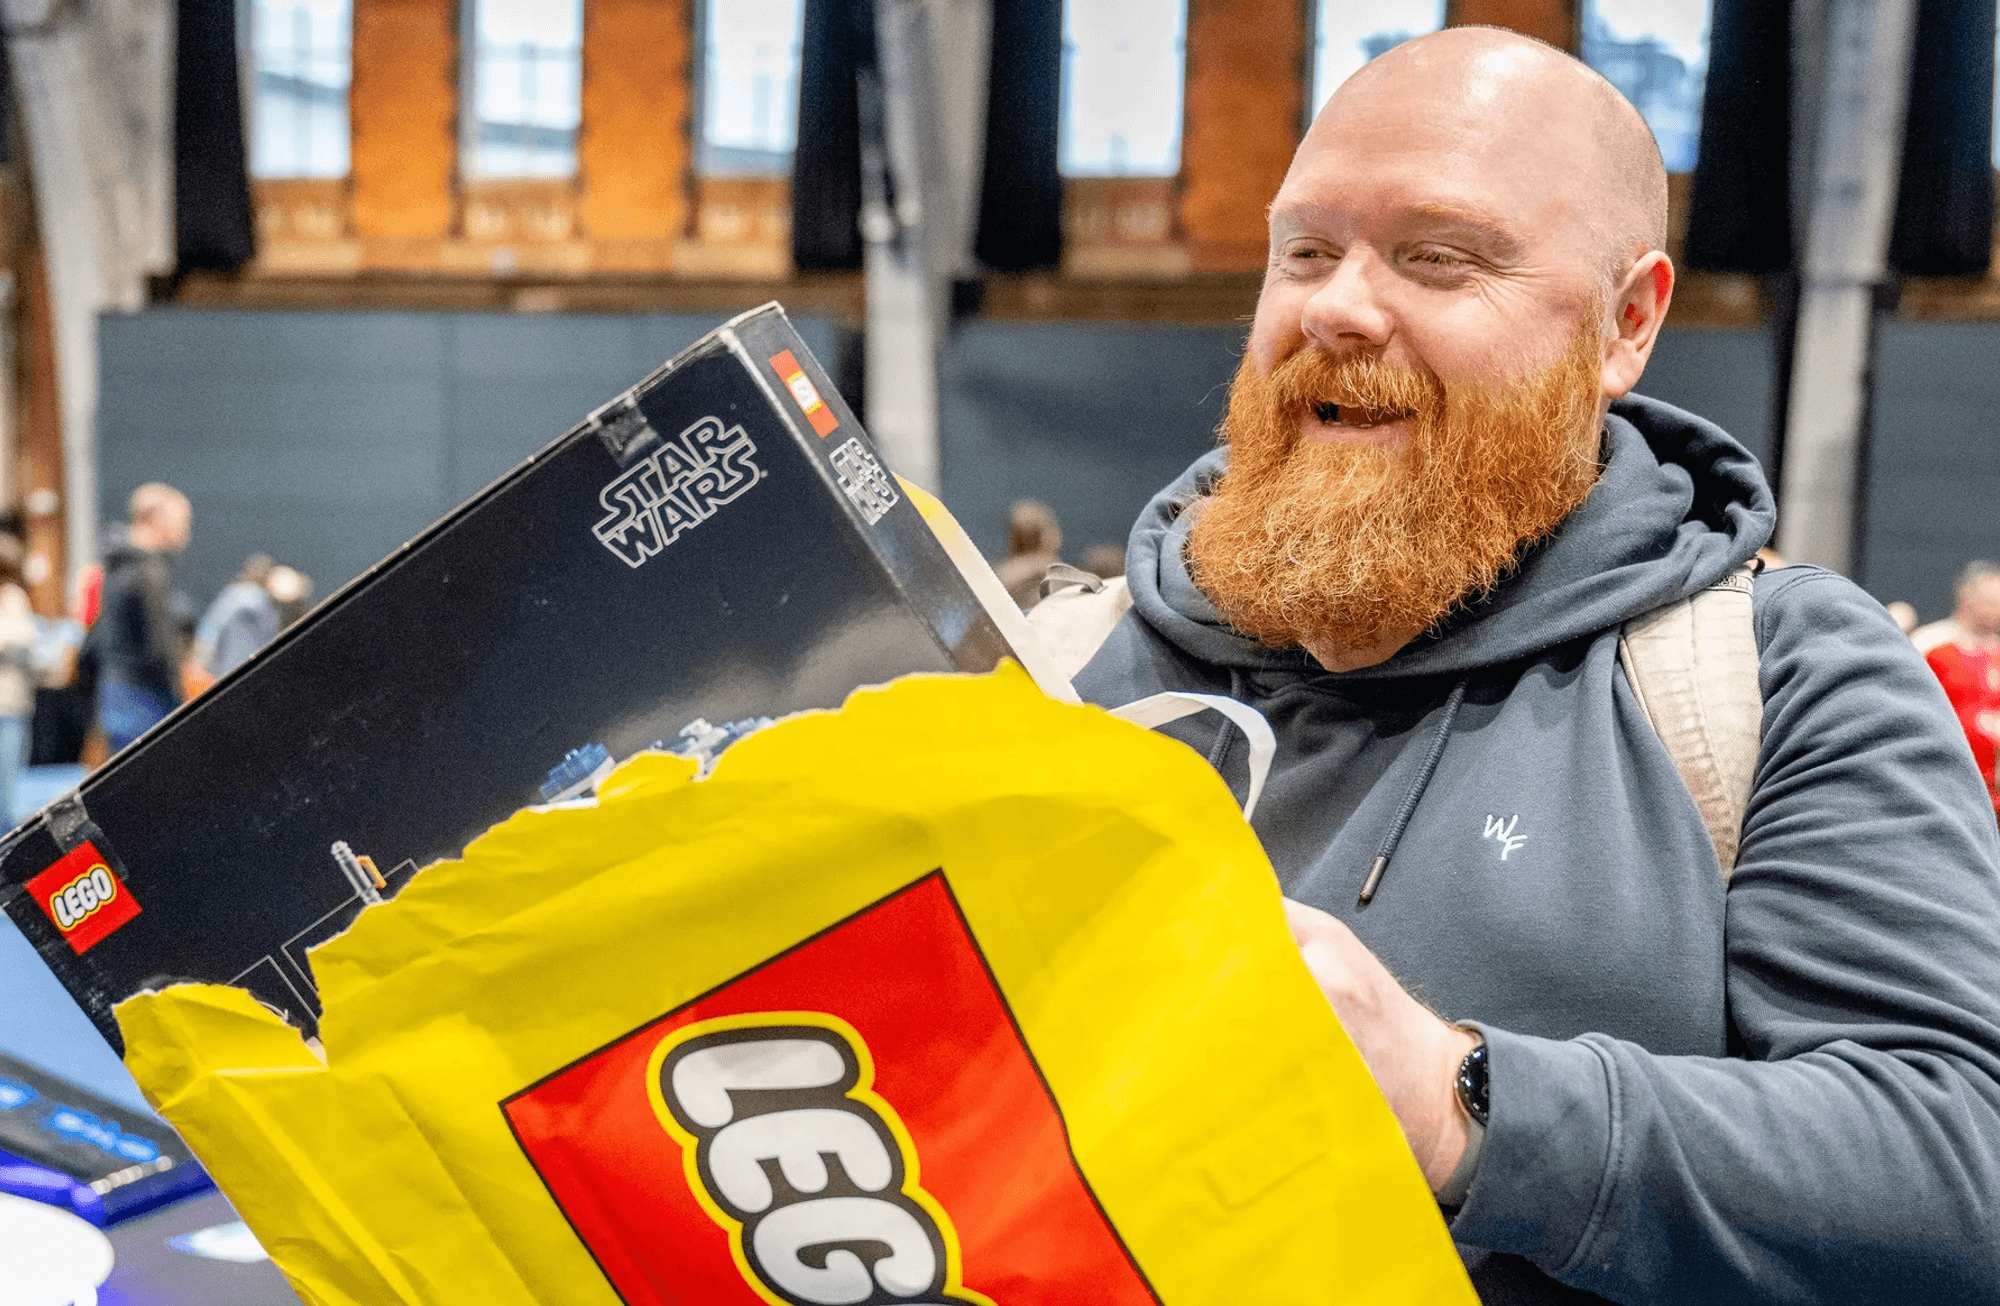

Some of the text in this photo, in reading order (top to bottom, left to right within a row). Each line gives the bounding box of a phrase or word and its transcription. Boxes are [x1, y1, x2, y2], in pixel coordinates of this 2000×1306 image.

[591, 416, 748, 541] STAR
[601, 438, 760, 569] WARS
[52, 866, 115, 929] LEGO
[668, 1034, 955, 1306] LEG
